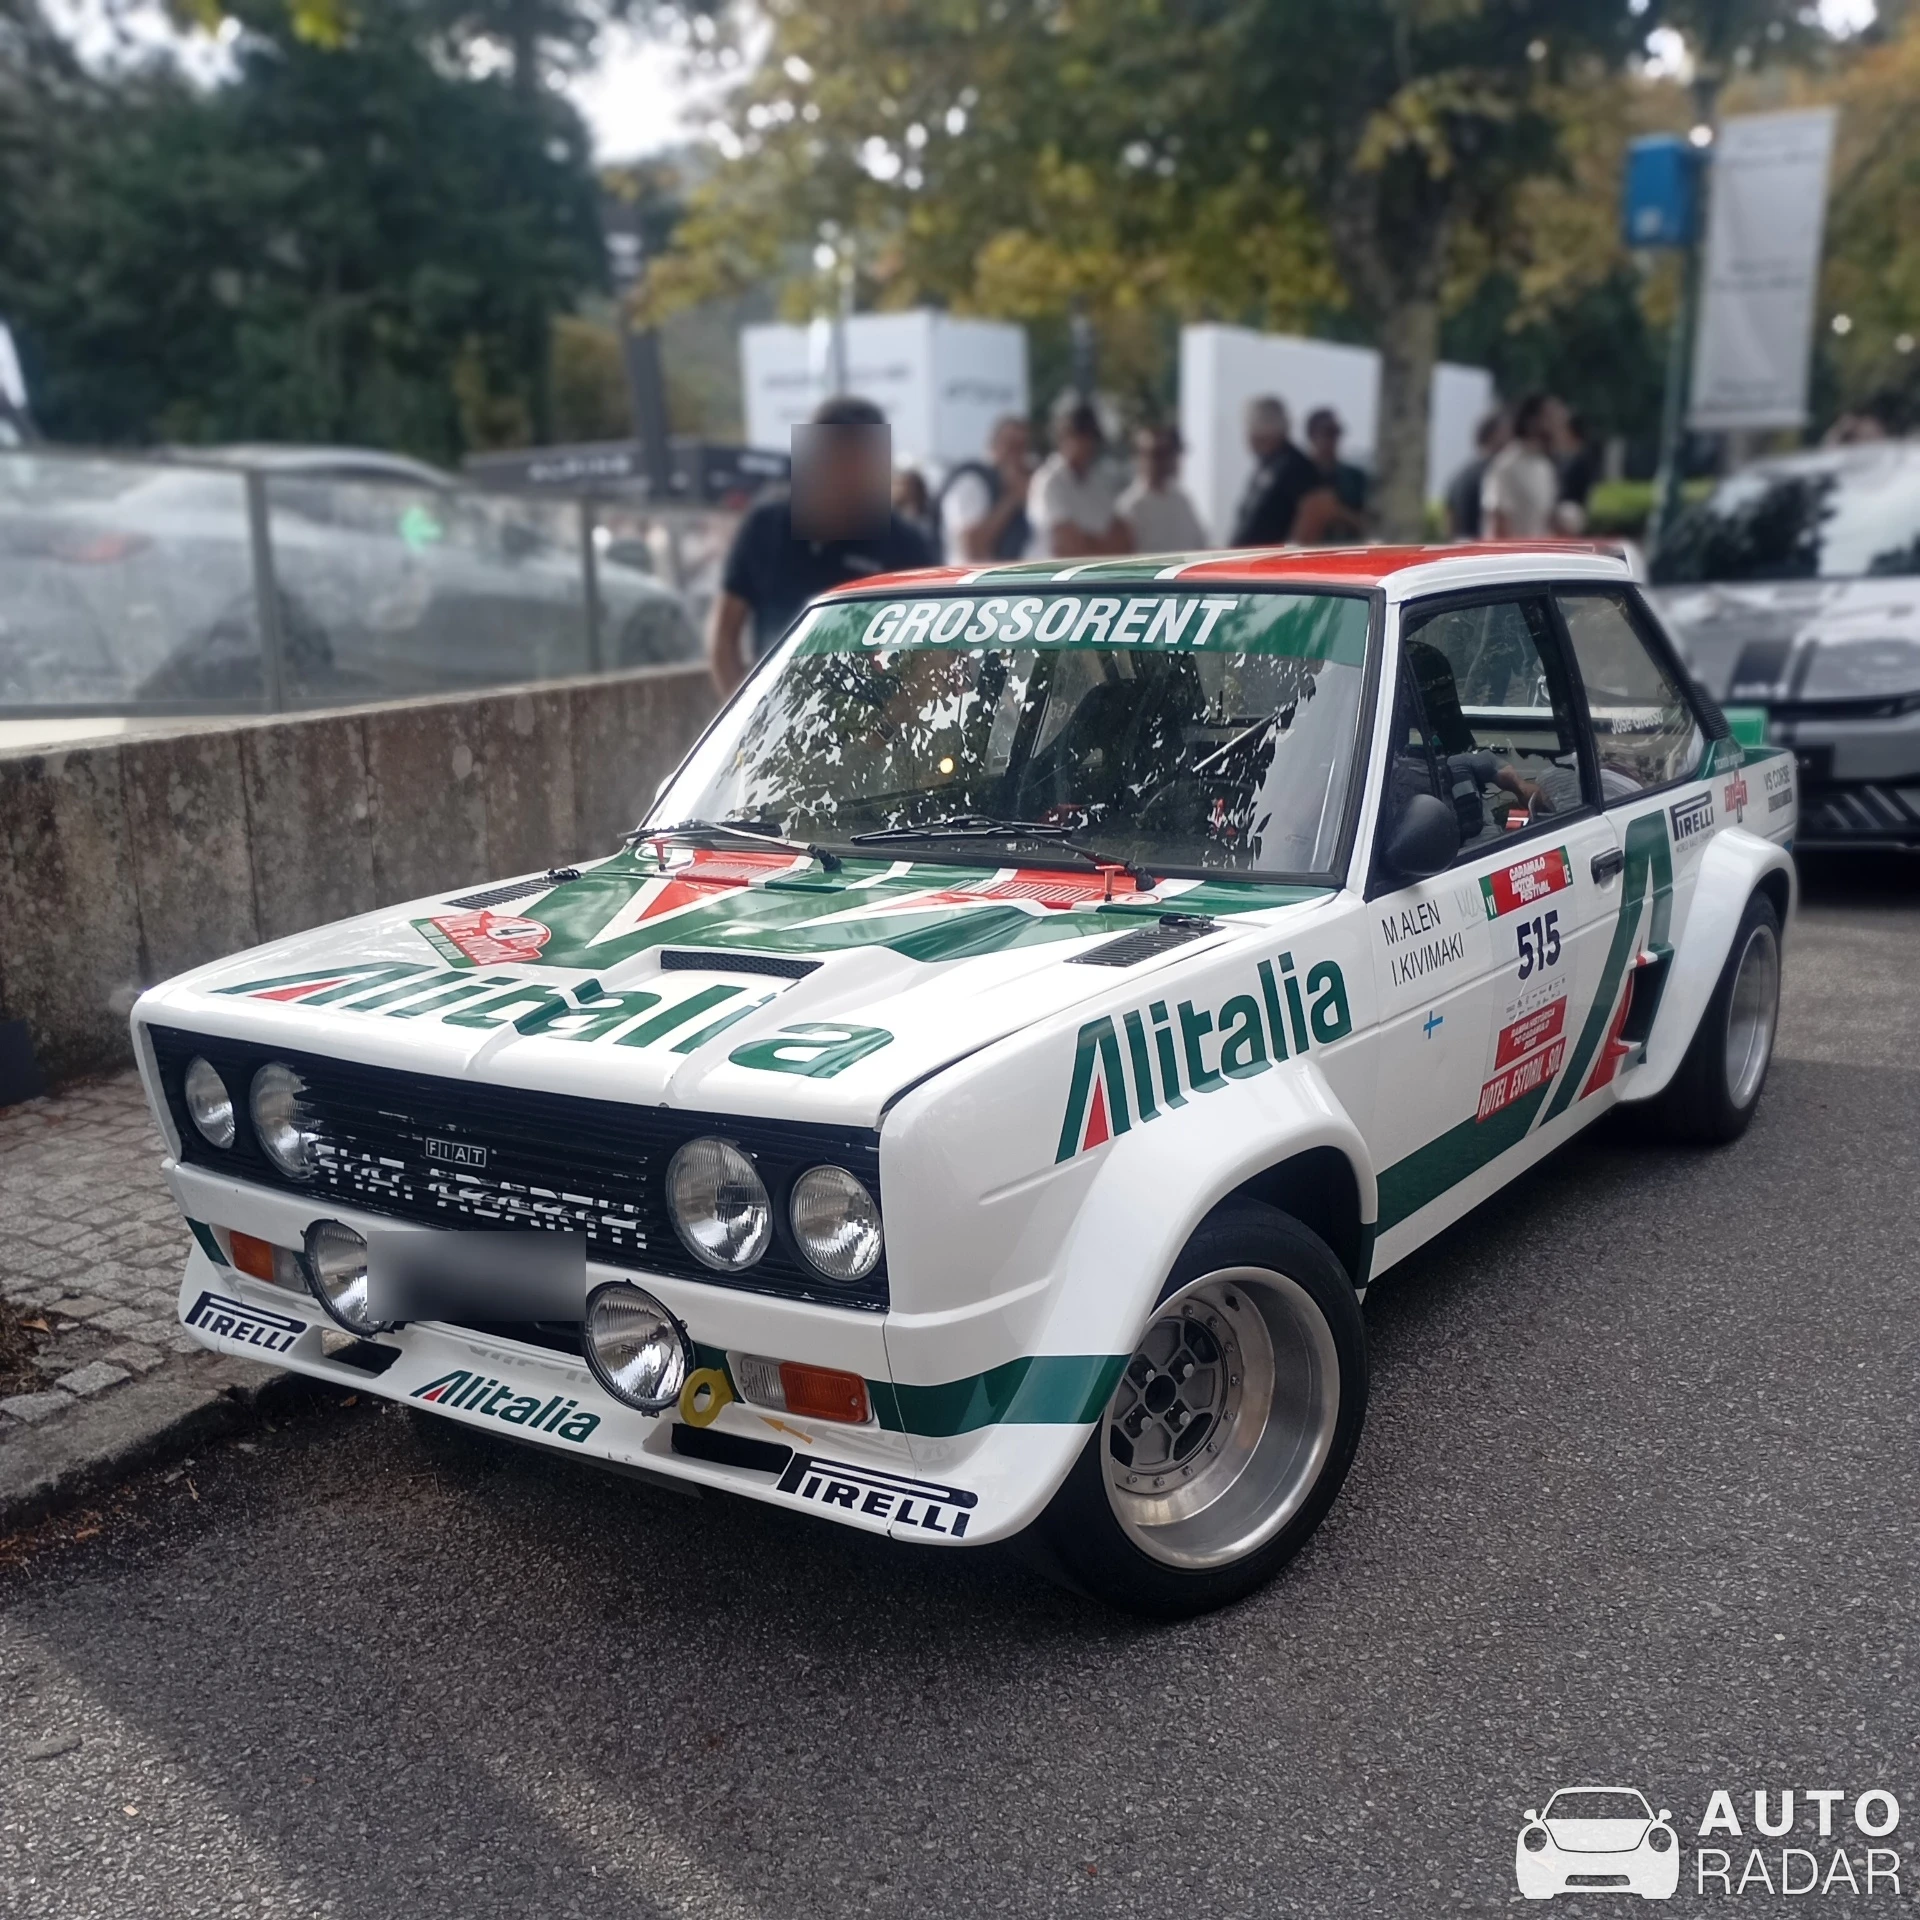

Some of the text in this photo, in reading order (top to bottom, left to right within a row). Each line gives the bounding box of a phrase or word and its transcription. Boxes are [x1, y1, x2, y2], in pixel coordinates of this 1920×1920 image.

[861, 597, 1238, 646] GROSSORENT
[1669, 790, 1714, 842] PIRELLI
[1381, 899, 1441, 946] M.ALEN
[1516, 910, 1561, 980] 515
[1391, 931, 1464, 987] I.KIVIMAKI
[209, 961, 895, 1079] Alitalia
[1054, 952, 1352, 1164] Alitalia
[1477, 1076, 1508, 1120] HOTEL
[427, 1139, 485, 1166] FIAT
[184, 1291, 308, 1353] PIRELLI
[410, 1369, 601, 1444] Alitalia
[777, 1452, 979, 1537] PIRELLI
